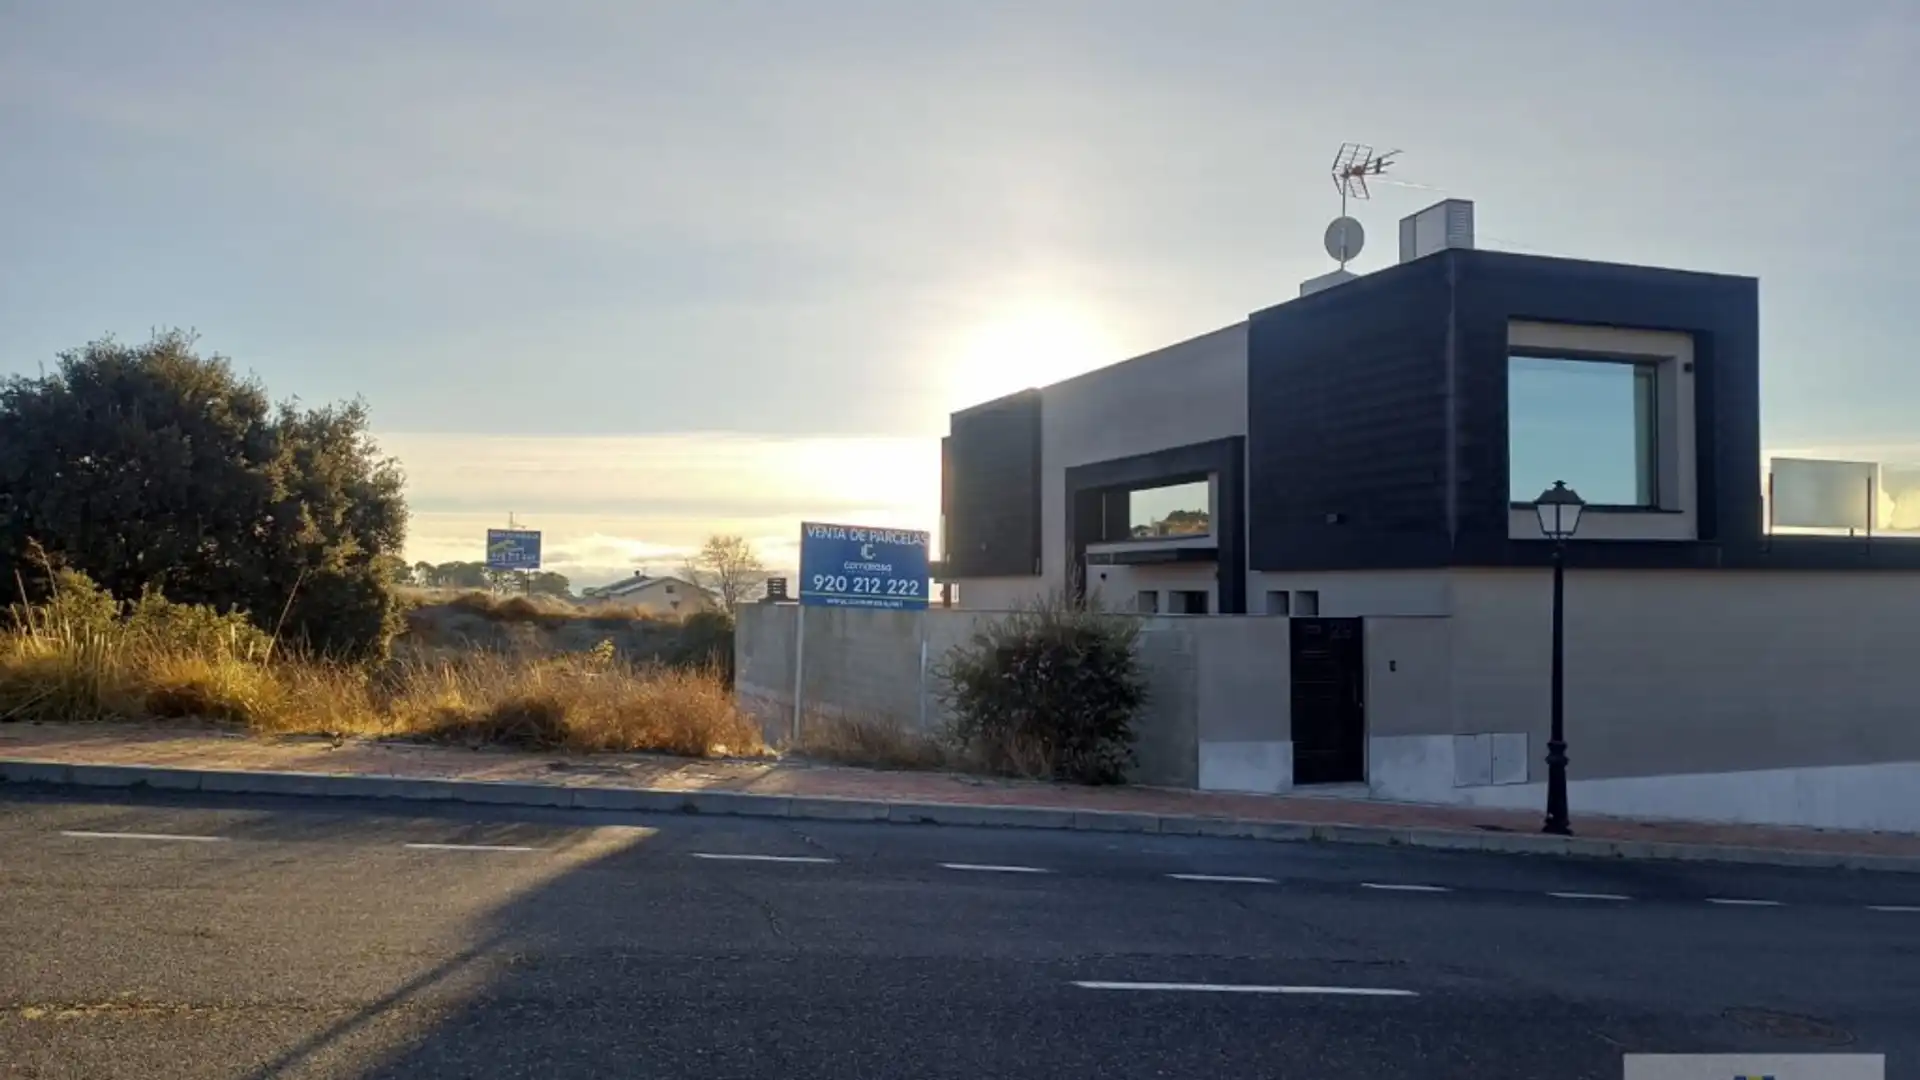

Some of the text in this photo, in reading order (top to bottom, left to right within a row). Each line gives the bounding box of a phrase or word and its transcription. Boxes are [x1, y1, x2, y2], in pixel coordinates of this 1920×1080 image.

[807, 526, 926, 546] VENTA DE PARCELAS
[813, 574, 919, 596] 920 212 222
